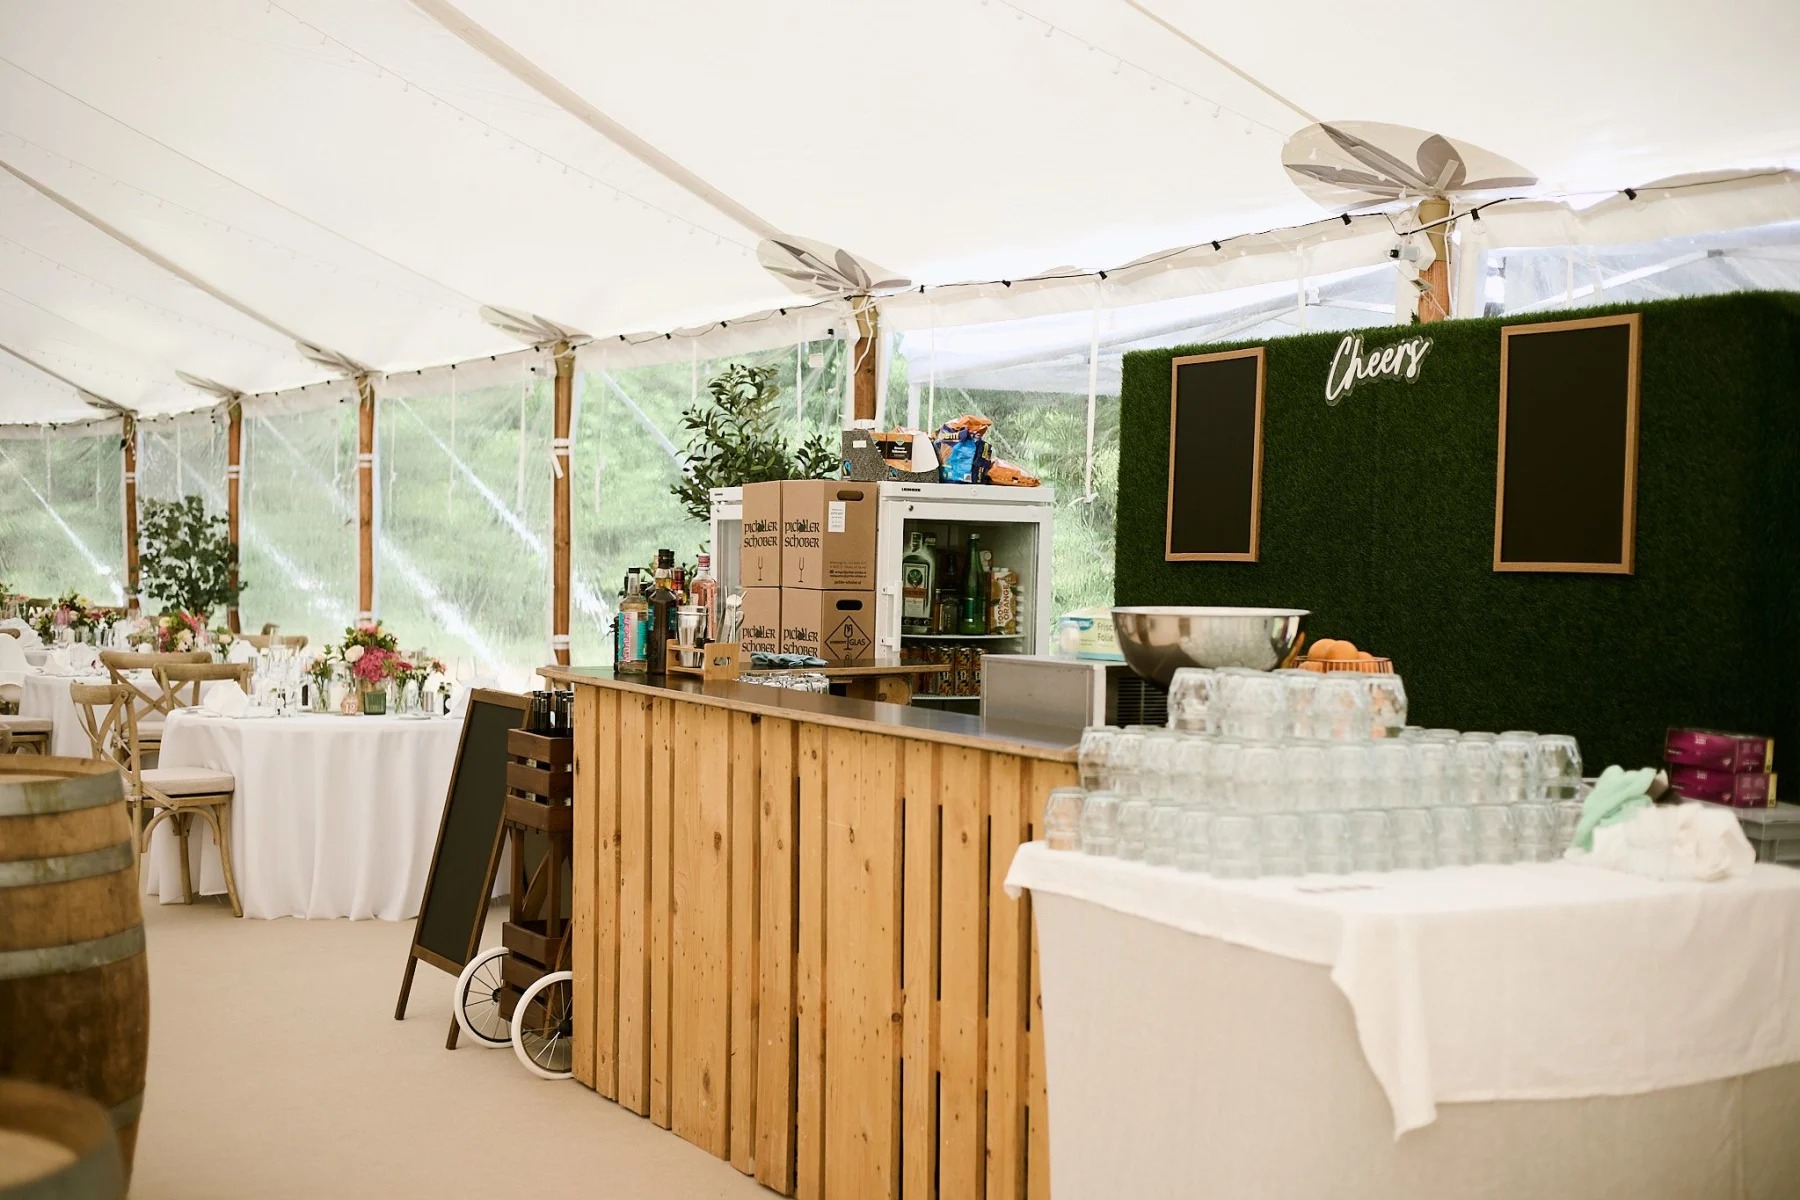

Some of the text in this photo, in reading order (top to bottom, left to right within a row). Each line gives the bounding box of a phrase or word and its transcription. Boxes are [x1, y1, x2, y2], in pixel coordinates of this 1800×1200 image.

[1326, 335, 1430, 401] Cheers
[1003, 584, 1011, 620] ORANGE
[849, 638, 866, 646] GLAS
